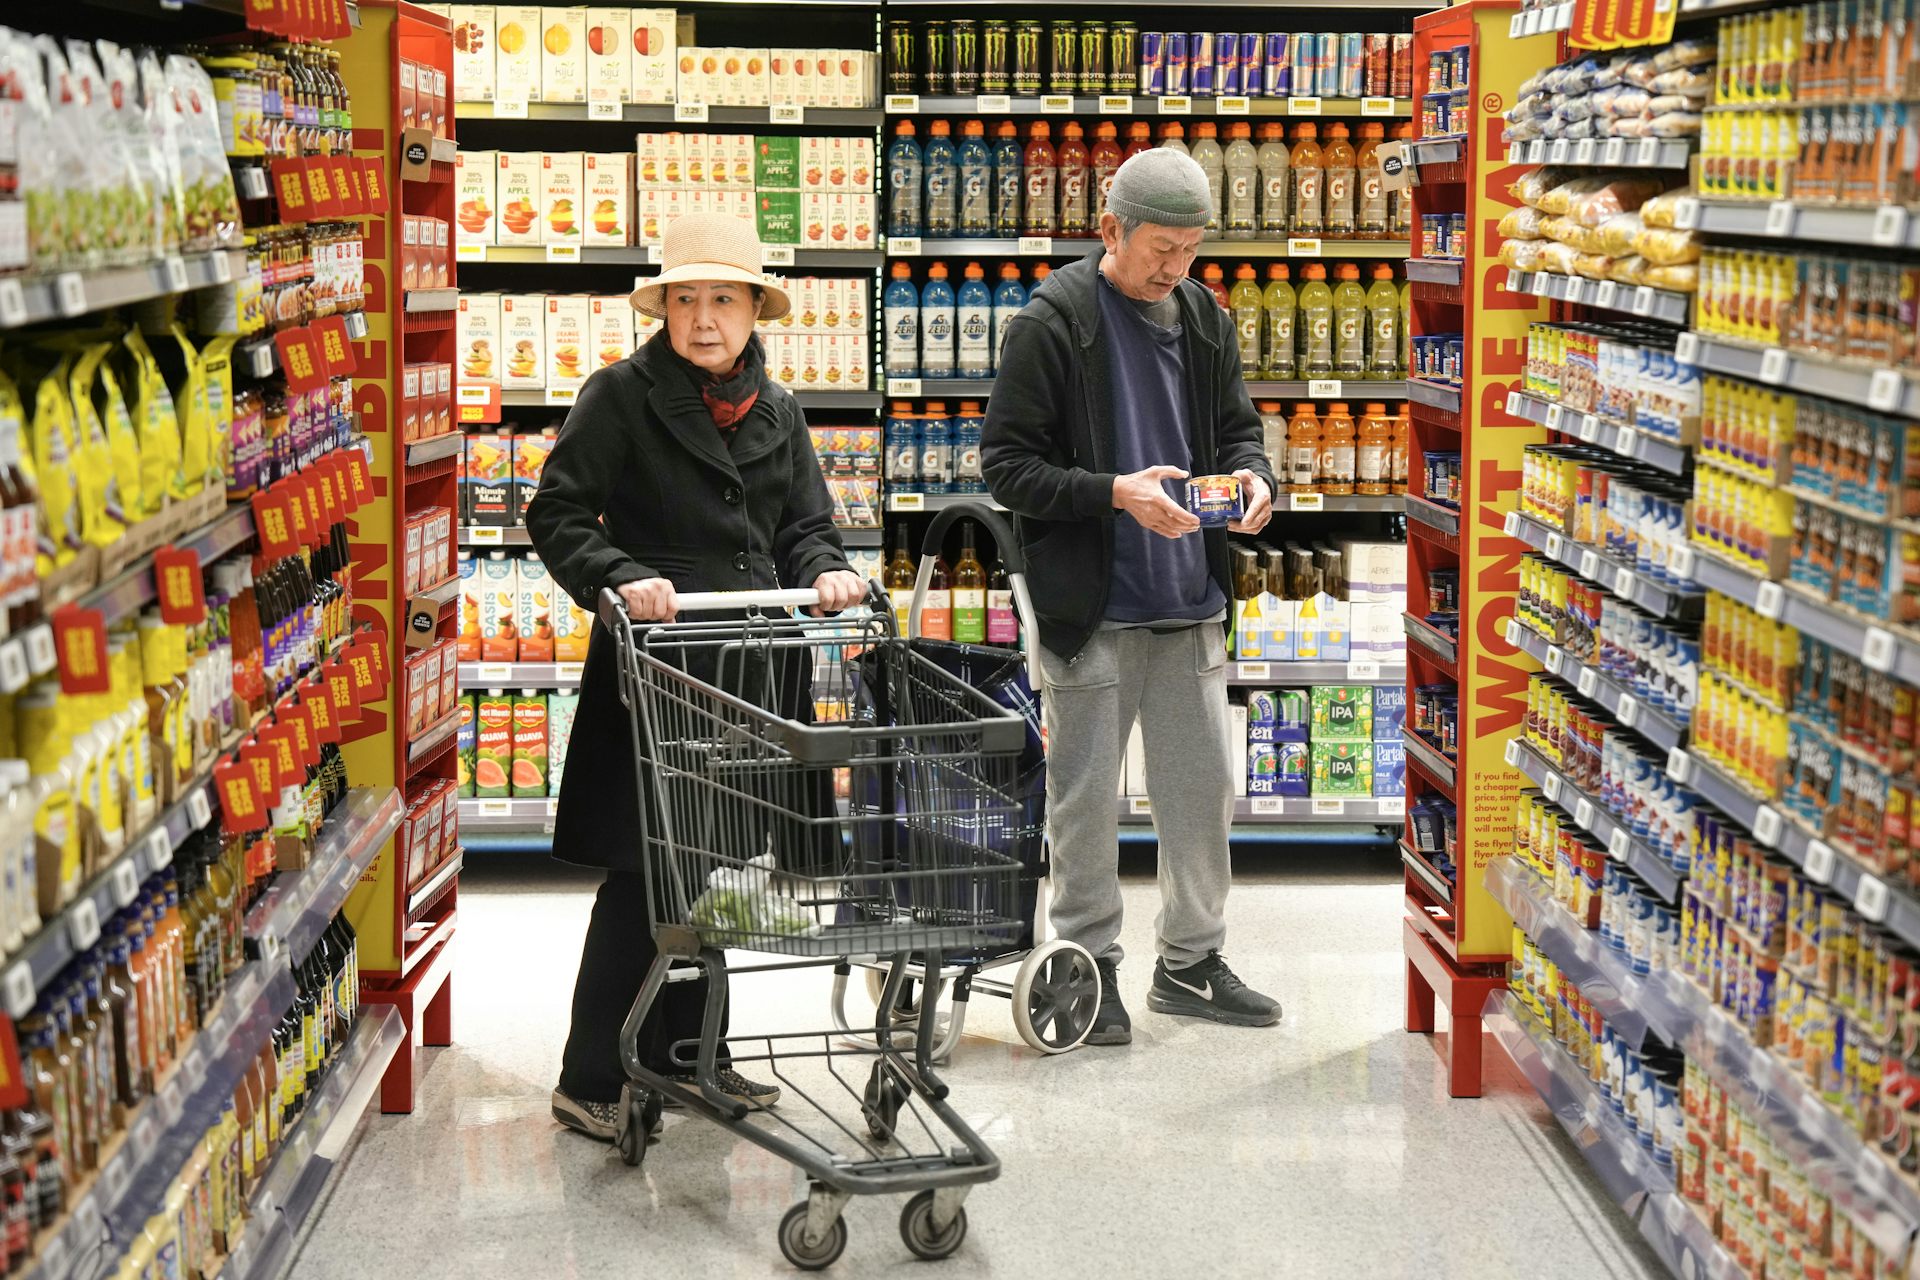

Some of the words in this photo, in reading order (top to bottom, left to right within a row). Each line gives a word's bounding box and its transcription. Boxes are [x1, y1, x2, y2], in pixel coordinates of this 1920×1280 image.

[601, 66, 619, 77] kiju
[646, 67, 664, 79] kiju
[307, 170, 321, 202] DROP
[314, 167, 331, 201] PRICE
[335, 168, 350, 200] PRICE
[368, 169, 380, 199] PRICE
[891, 169, 904, 188] G
[928, 174, 943, 196] G
[967, 176, 981, 196] G
[1004, 176, 1018, 196] G
[1028, 176, 1042, 196] G
[1066, 176, 1081, 196] G
[1233, 177, 1247, 198] G
[1268, 177, 1281, 197] G
[1301, 178, 1315, 199] G
[1330, 178, 1344, 199] G
[1364, 178, 1378, 198] G
[894, 325, 916, 334] ZERO
[928, 325, 950, 334] ZERO
[963, 325, 986, 334] ZERO
[1242, 318, 1256, 339] G
[1277, 318, 1290, 339] G
[1314, 318, 1327, 339] G
[1341, 318, 1356, 339] G
[1378, 318, 1392, 339] G
[330, 330, 345, 360] PRICE
[1480, 337, 1536, 427] BE
[899, 450, 913, 468] G
[923, 450, 937, 468] G
[962, 450, 976, 468] G
[1322, 452, 1334, 468] G
[351, 461, 364, 491] PRICE
[320, 477, 335, 509] PRICE
[1201, 504, 1232, 512] PLANTERS
[485, 592, 496, 638] OASIS
[521, 592, 532, 638] OASIS
[558, 592, 568, 638] OASIS
[370, 642, 382, 671] PRICE
[350, 658, 363, 688] DROP
[358, 656, 372, 686] PRICE
[330, 677, 341, 708] DROP
[339, 676, 350, 707] PRICE
[306, 698, 320, 729] DROP
[316, 696, 329, 728] PRICE
[1332, 707, 1353, 718] IPA
[480, 732, 509, 742] GUAVA
[514, 732, 544, 742] GUAVA
[1332, 762, 1353, 773] IPA
[1484, 774, 1499, 784] you
[1484, 783, 1518, 793] cheaper
[1475, 795, 1498, 803] price,
[1474, 850, 1494, 861] flyer
